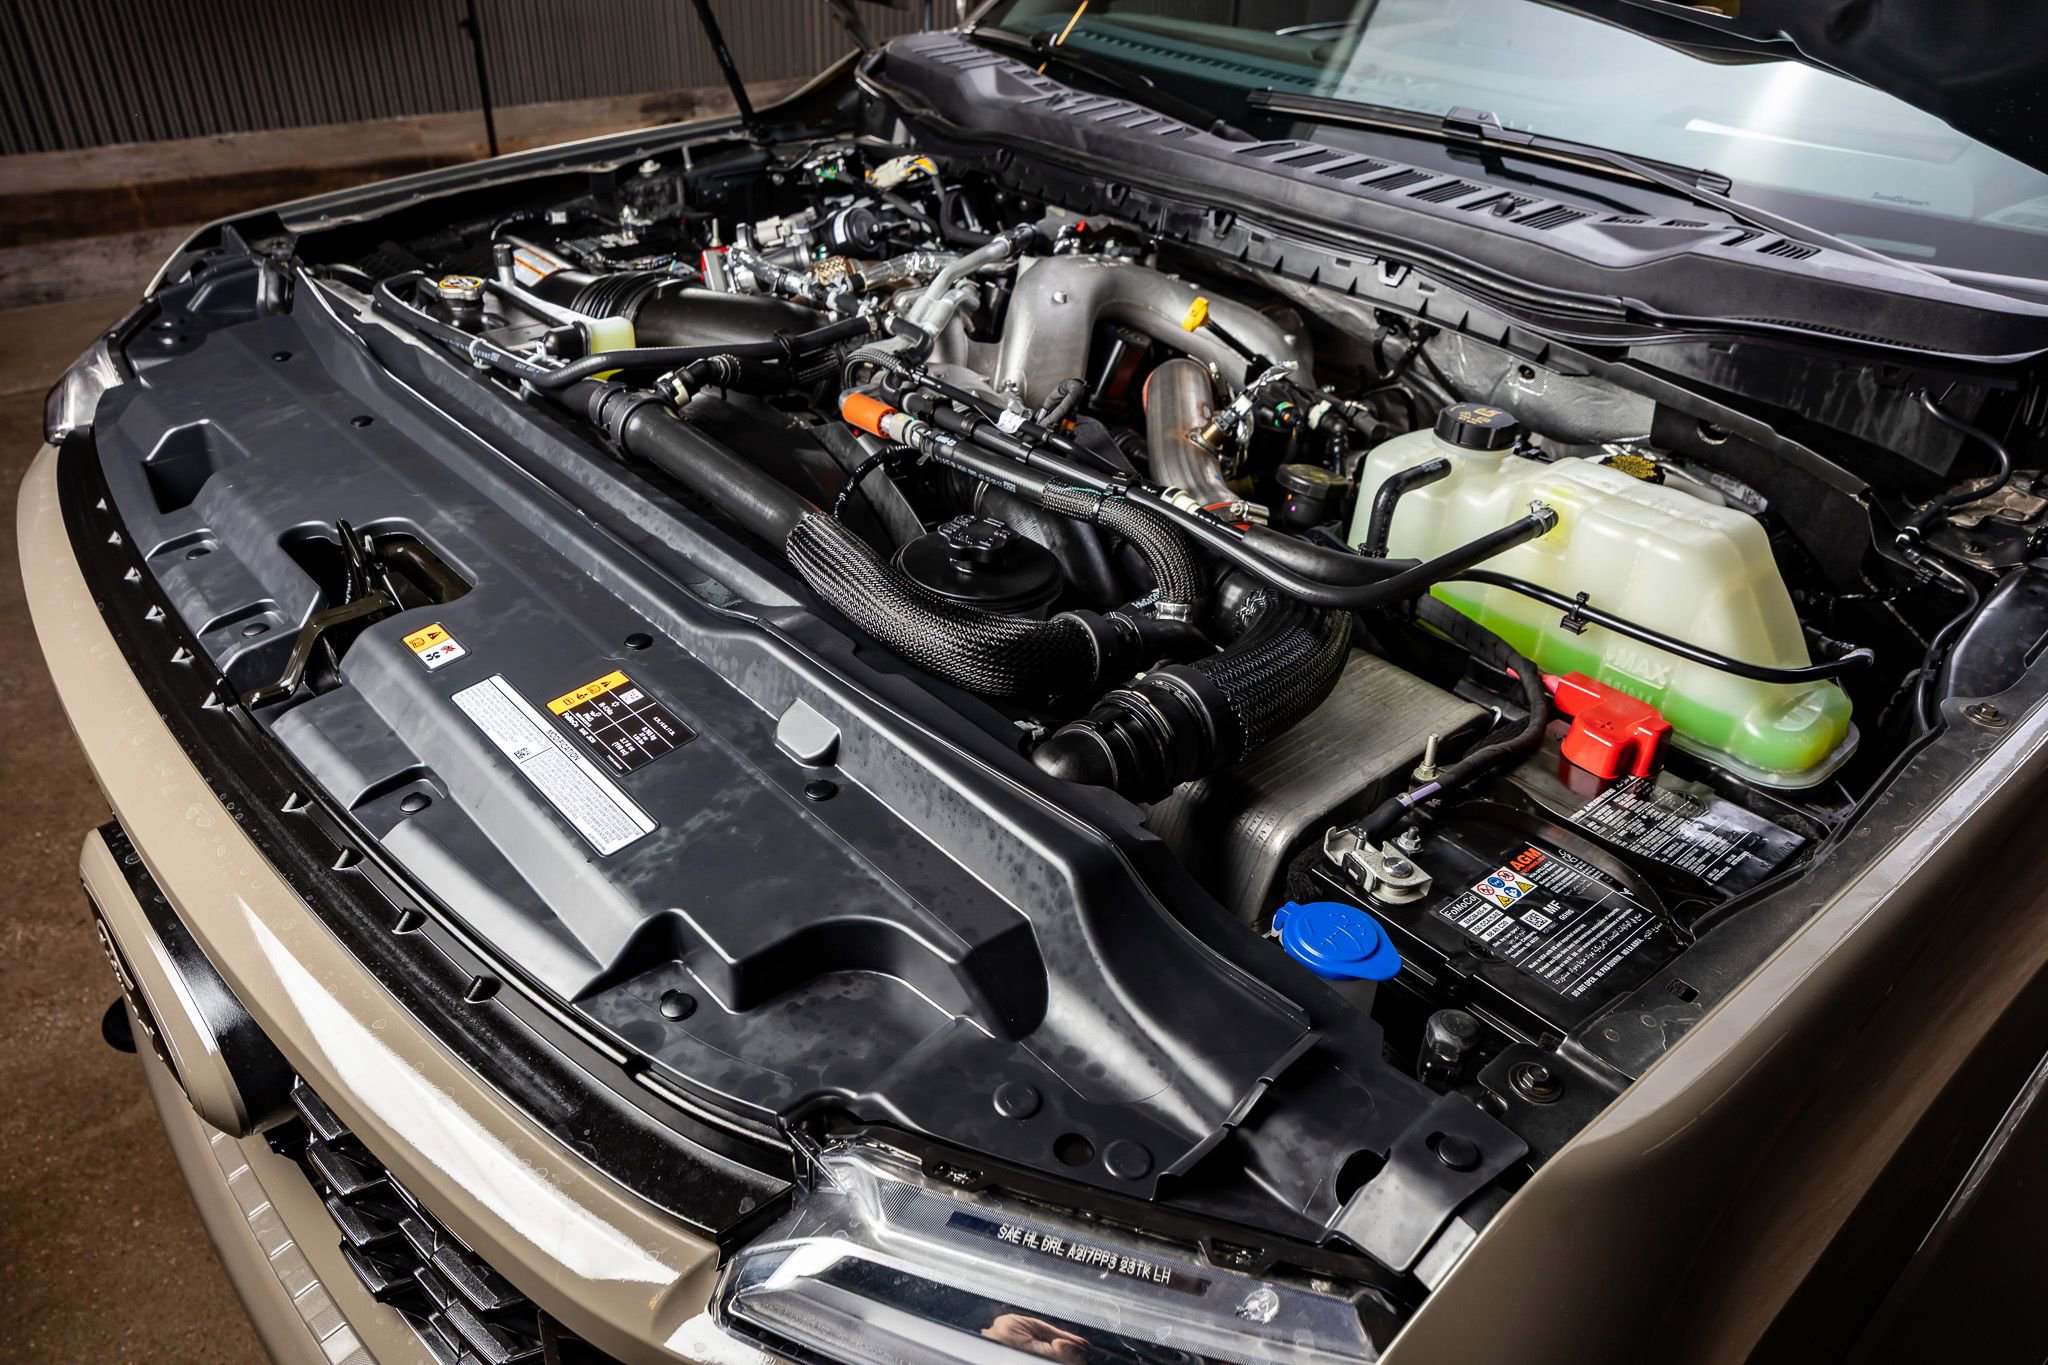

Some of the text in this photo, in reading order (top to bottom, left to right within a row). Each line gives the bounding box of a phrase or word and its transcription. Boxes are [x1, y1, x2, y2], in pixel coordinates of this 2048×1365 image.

[1615, 648, 1670, 684] MAX
[545, 728, 581, 761] MODIFICATION
[1507, 847, 1541, 870] AGM
[1443, 893, 1477, 918] FoMoCo
[1542, 899, 1564, 914] MF
[1497, 920, 1509, 929] C20
[1576, 983, 1587, 992] NOT
[998, 1224, 1023, 1244] SAE
[1022, 1230, 1039, 1248] HL
[1041, 1235, 1065, 1256] DRL
[1154, 1265, 1171, 1284] LH
